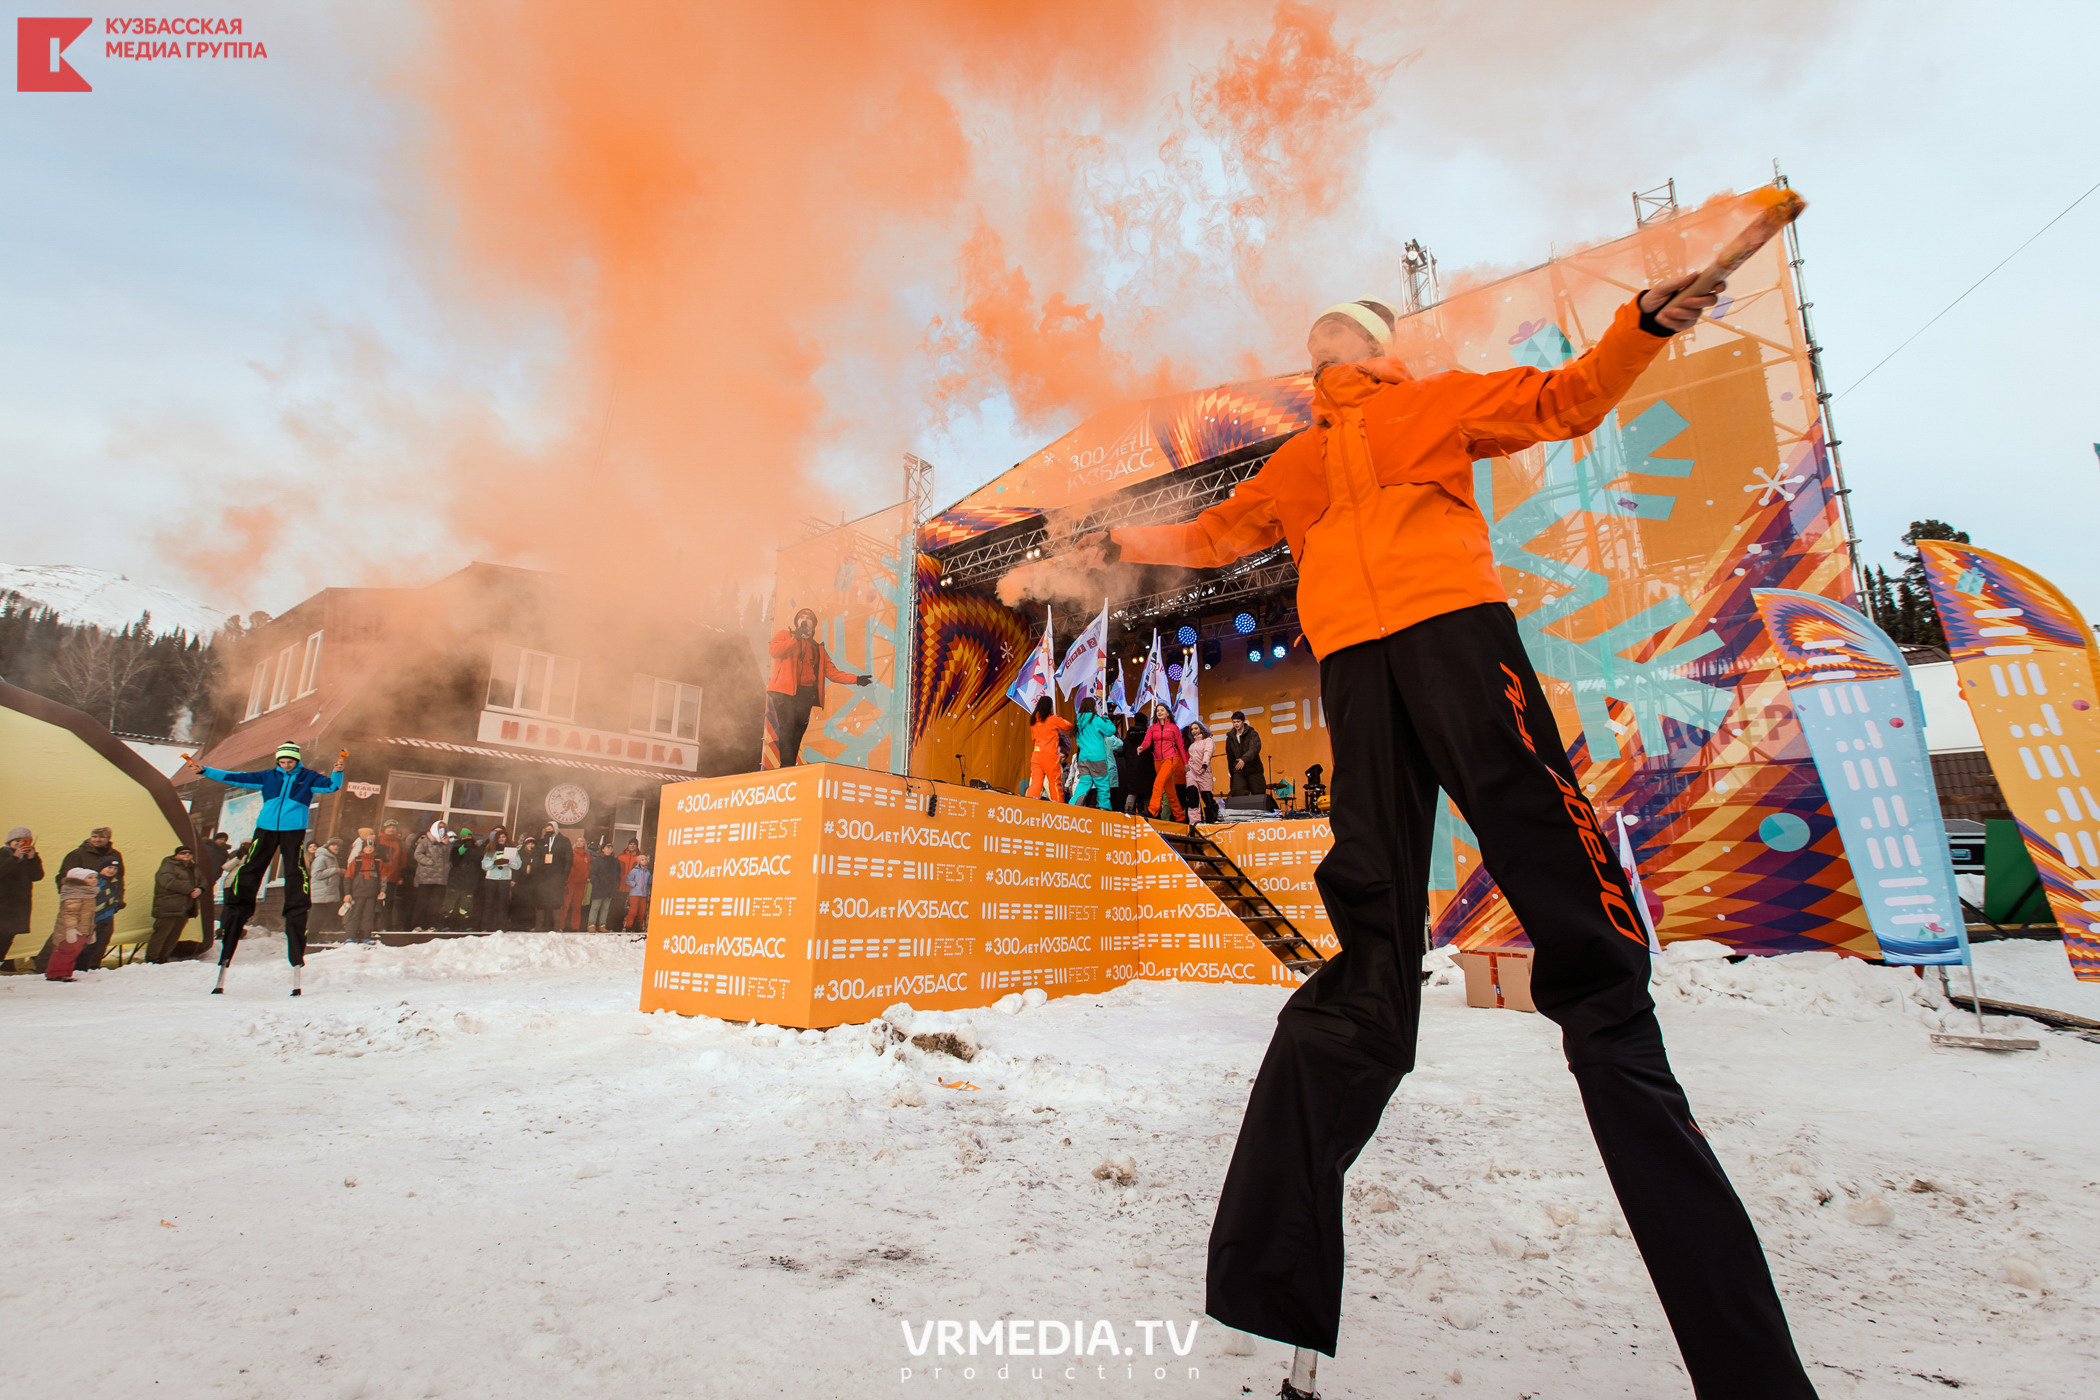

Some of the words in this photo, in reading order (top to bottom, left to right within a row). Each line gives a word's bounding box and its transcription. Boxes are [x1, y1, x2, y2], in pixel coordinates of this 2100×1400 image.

[1067, 448, 1155, 493] КУЗБАСС
[1068, 446, 1105, 473] 300
[501, 719, 684, 766] НЕВАЛЯШКА
